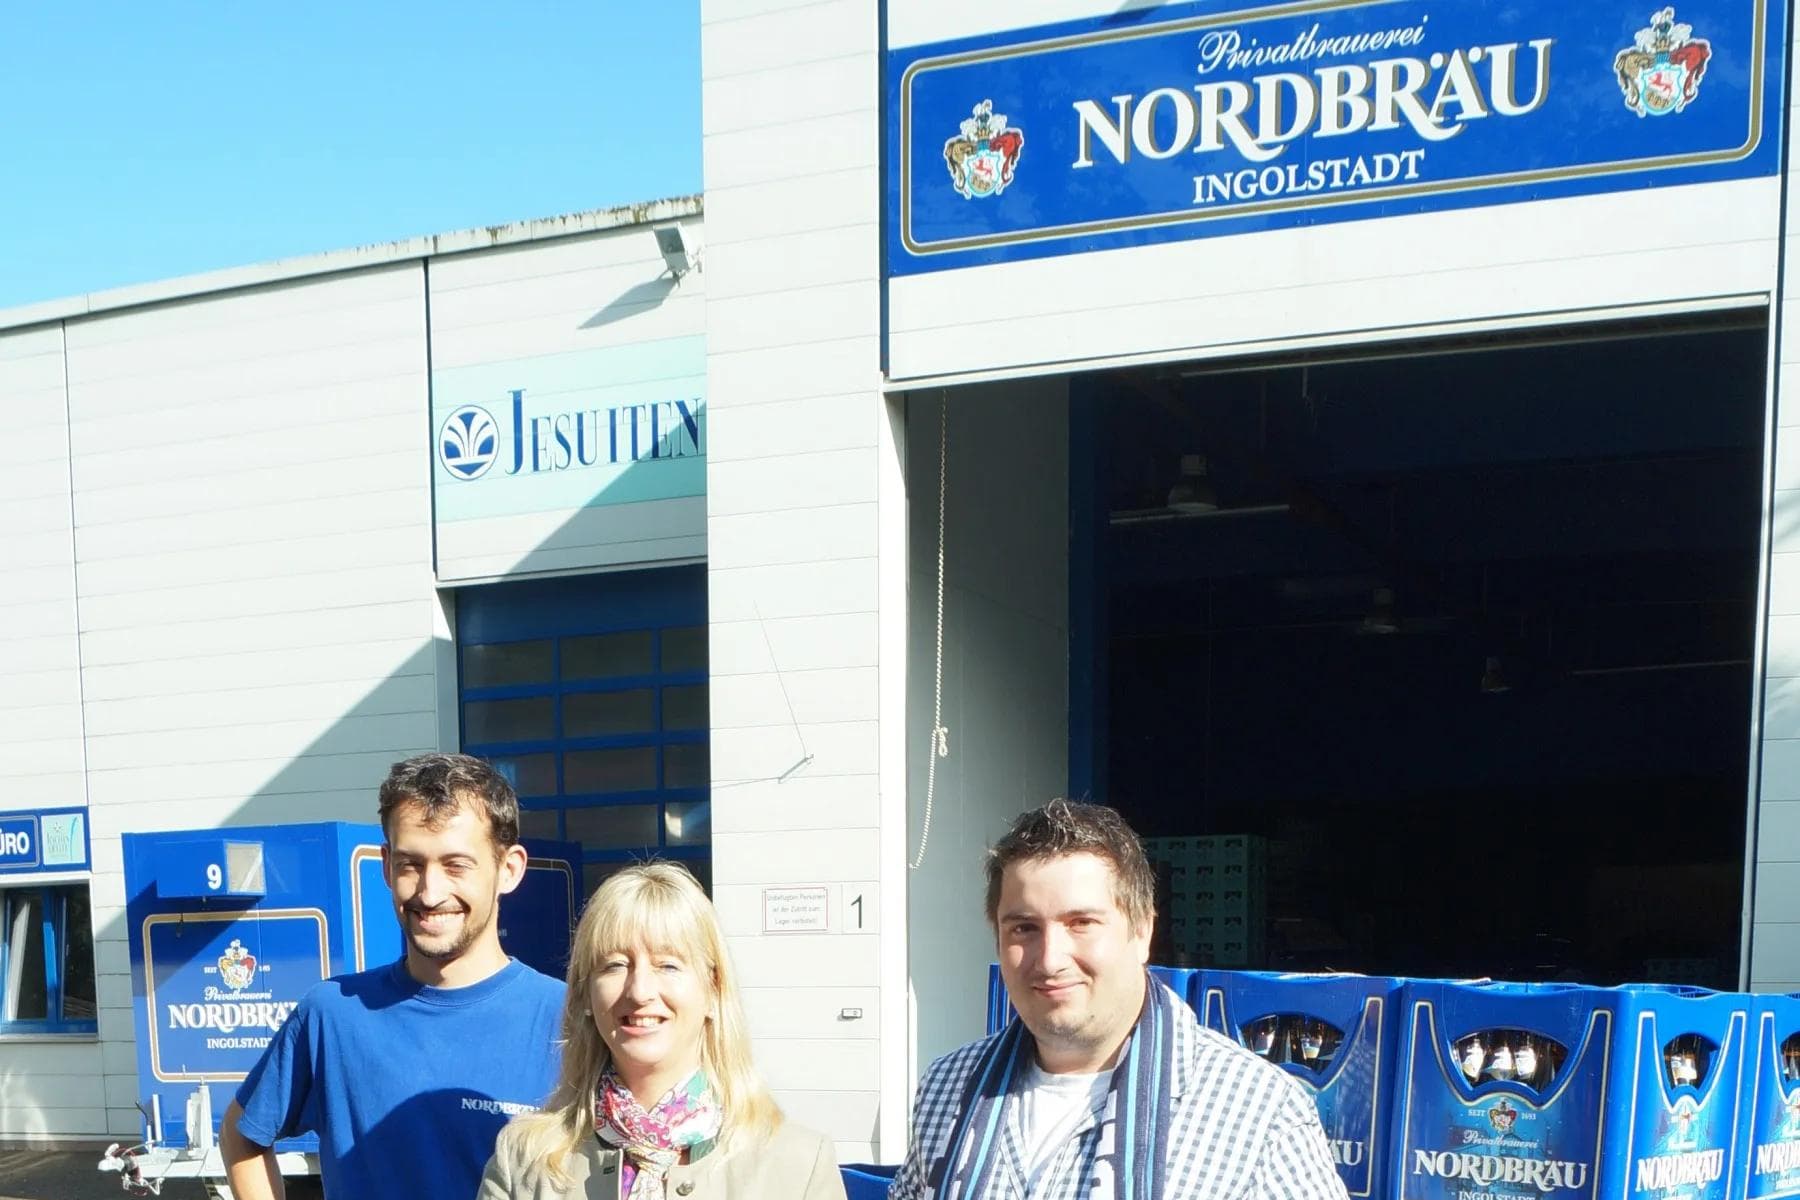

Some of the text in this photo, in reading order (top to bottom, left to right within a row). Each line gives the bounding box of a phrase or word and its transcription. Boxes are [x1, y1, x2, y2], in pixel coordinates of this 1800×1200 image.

[1196, 14, 1429, 74] Privatbrauerei
[1072, 38, 1554, 169] NORDBRÄU
[1193, 149, 1426, 204] INGOLSTADT
[207, 864, 222, 889] 9
[851, 894, 862, 929] 1
[168, 1001, 298, 1033] NORDBRÄ
[1463, 1129, 1540, 1150] Privatbrauerei
[1413, 1149, 1587, 1194] NORDBRÄU
